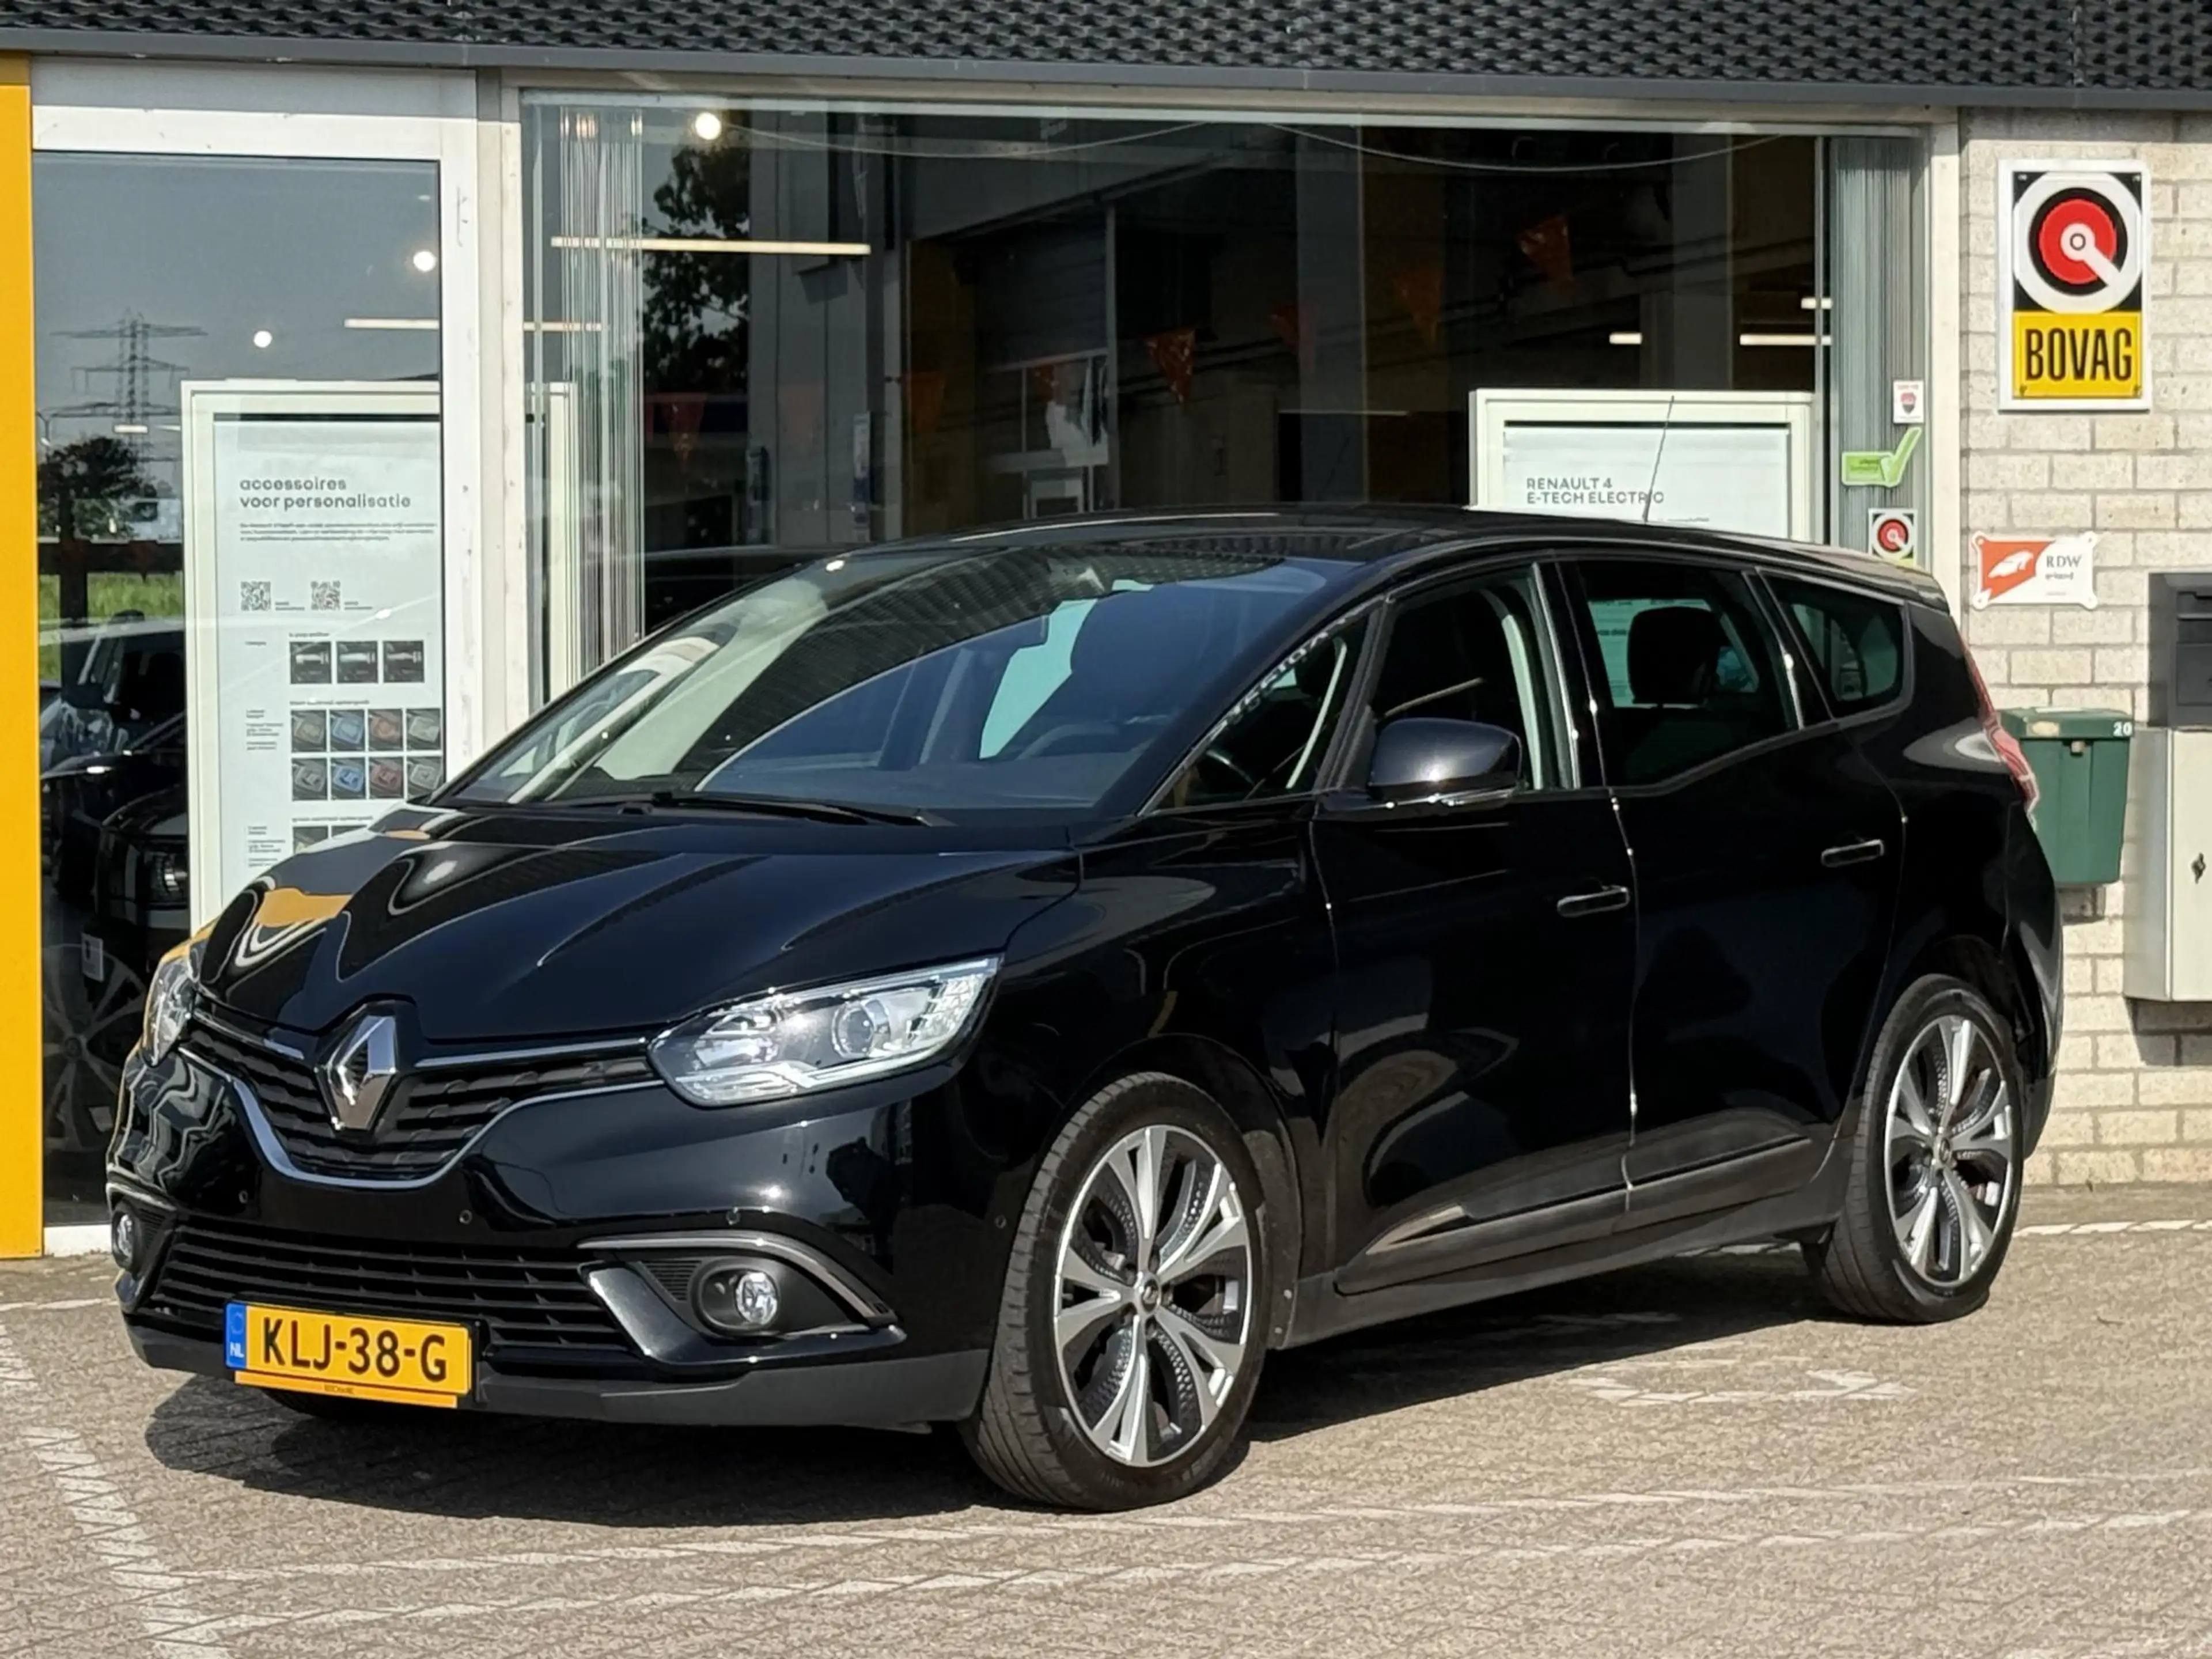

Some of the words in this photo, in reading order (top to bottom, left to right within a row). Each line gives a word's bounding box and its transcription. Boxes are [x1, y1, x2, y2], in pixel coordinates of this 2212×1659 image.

[2025, 327, 2133, 381] BOVAG
[240, 476, 347, 490] accessoires
[1527, 478, 1600, 490] RENAULT
[1603, 478, 1613, 490] 4
[240, 496, 280, 508] voor
[284, 493, 411, 512] personalisatie
[1527, 492, 1584, 504] E-TECH
[1589, 491, 1664, 504] ELECTRC
[2046, 555, 2082, 568] RDW
[2112, 721, 2133, 737] 20
[229, 1342, 245, 1358] NL
[263, 1316, 447, 1382] KLJ-38-G
